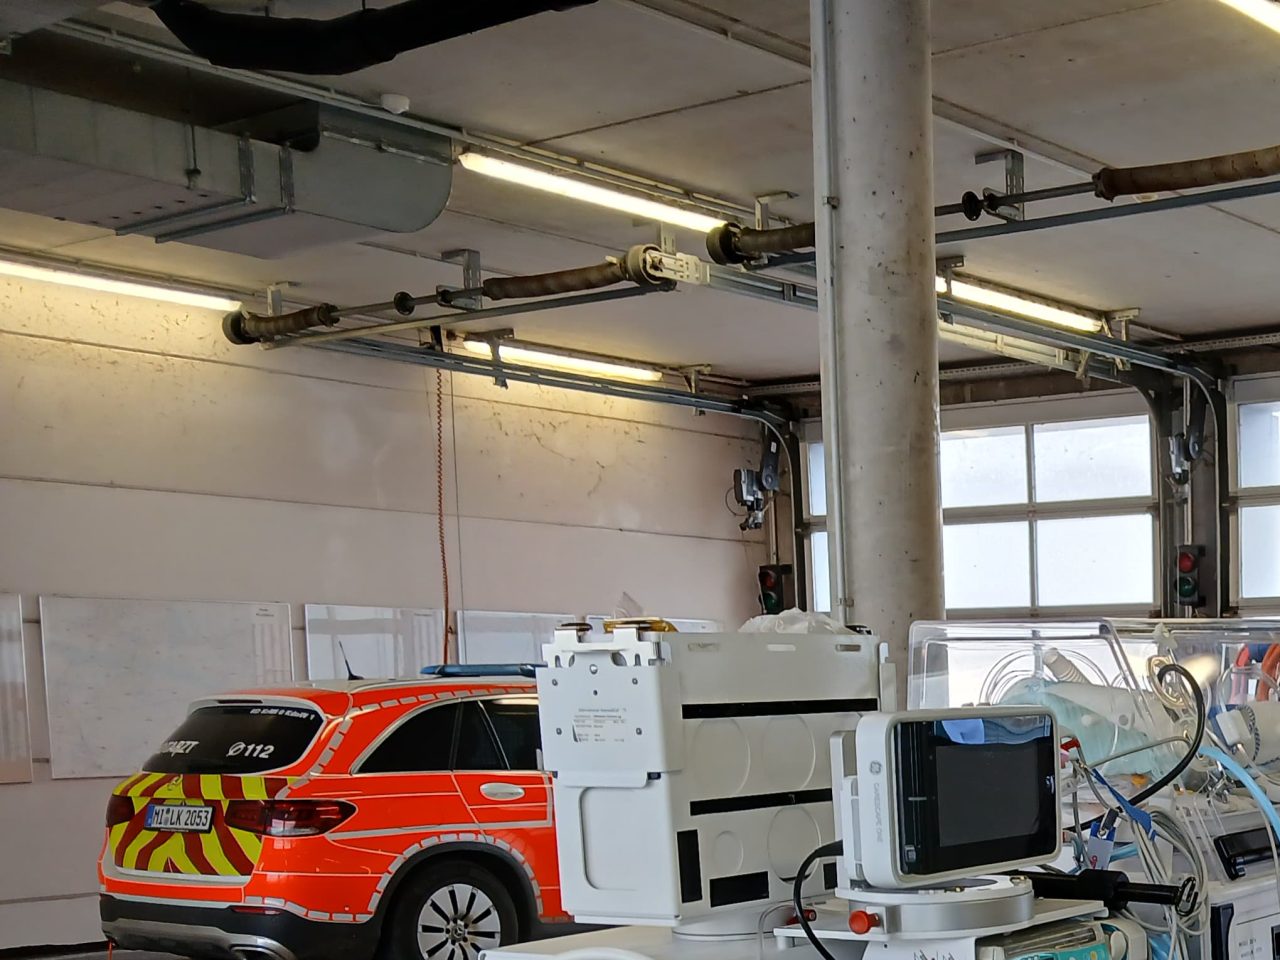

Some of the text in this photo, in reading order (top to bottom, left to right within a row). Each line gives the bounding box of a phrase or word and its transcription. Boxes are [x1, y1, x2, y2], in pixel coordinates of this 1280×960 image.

[244, 743, 275, 759] 112
[170, 808, 184, 826] LK
[184, 809, 210, 827] 2053
